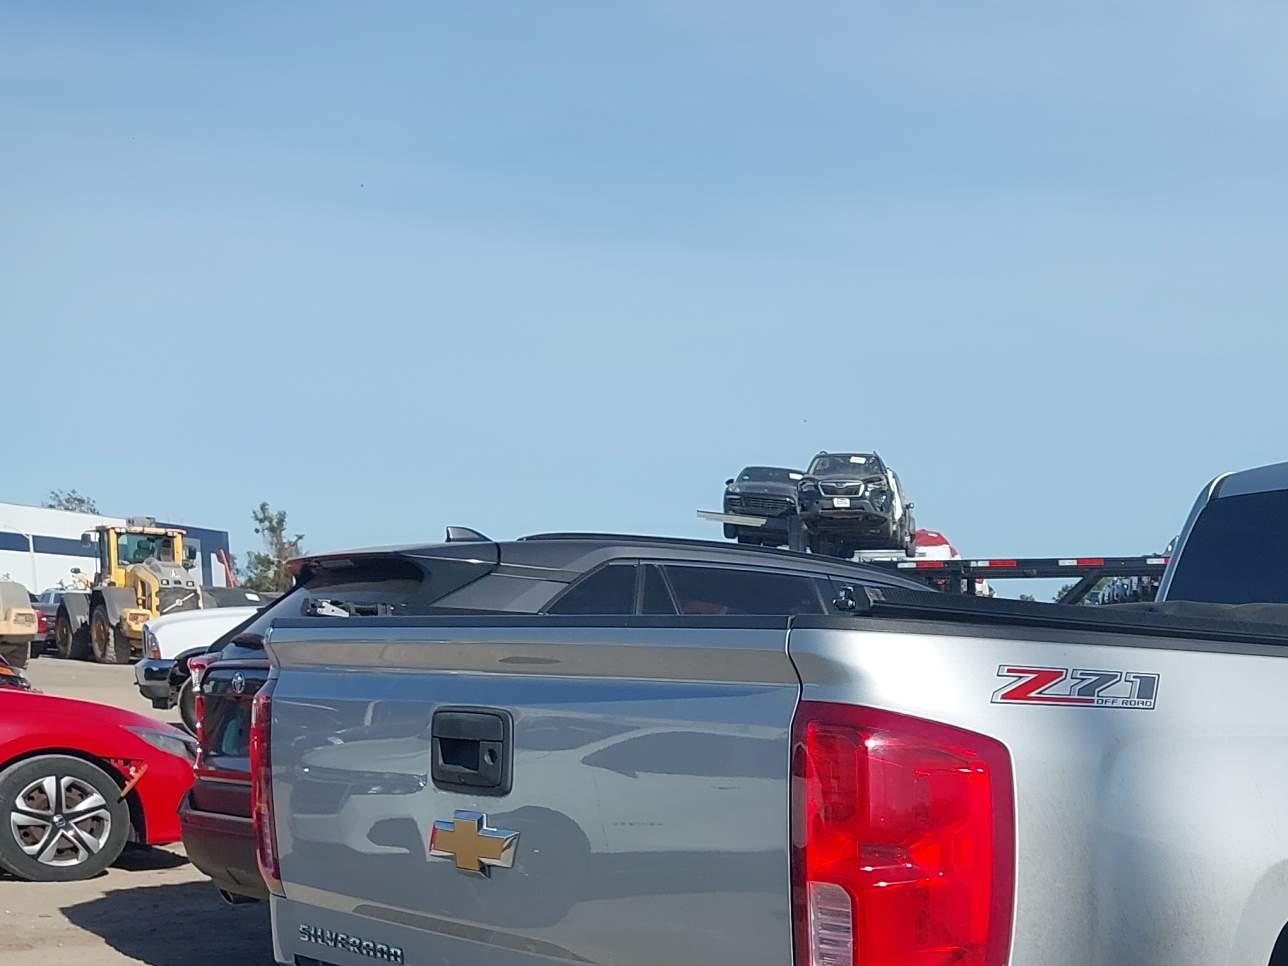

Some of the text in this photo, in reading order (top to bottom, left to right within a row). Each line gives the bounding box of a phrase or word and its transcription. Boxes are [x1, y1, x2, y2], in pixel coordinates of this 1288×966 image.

[990, 665, 1160, 710] Z71
[1120, 699, 1154, 708] ROAD
[299, 924, 405, 966] SILVERADO
